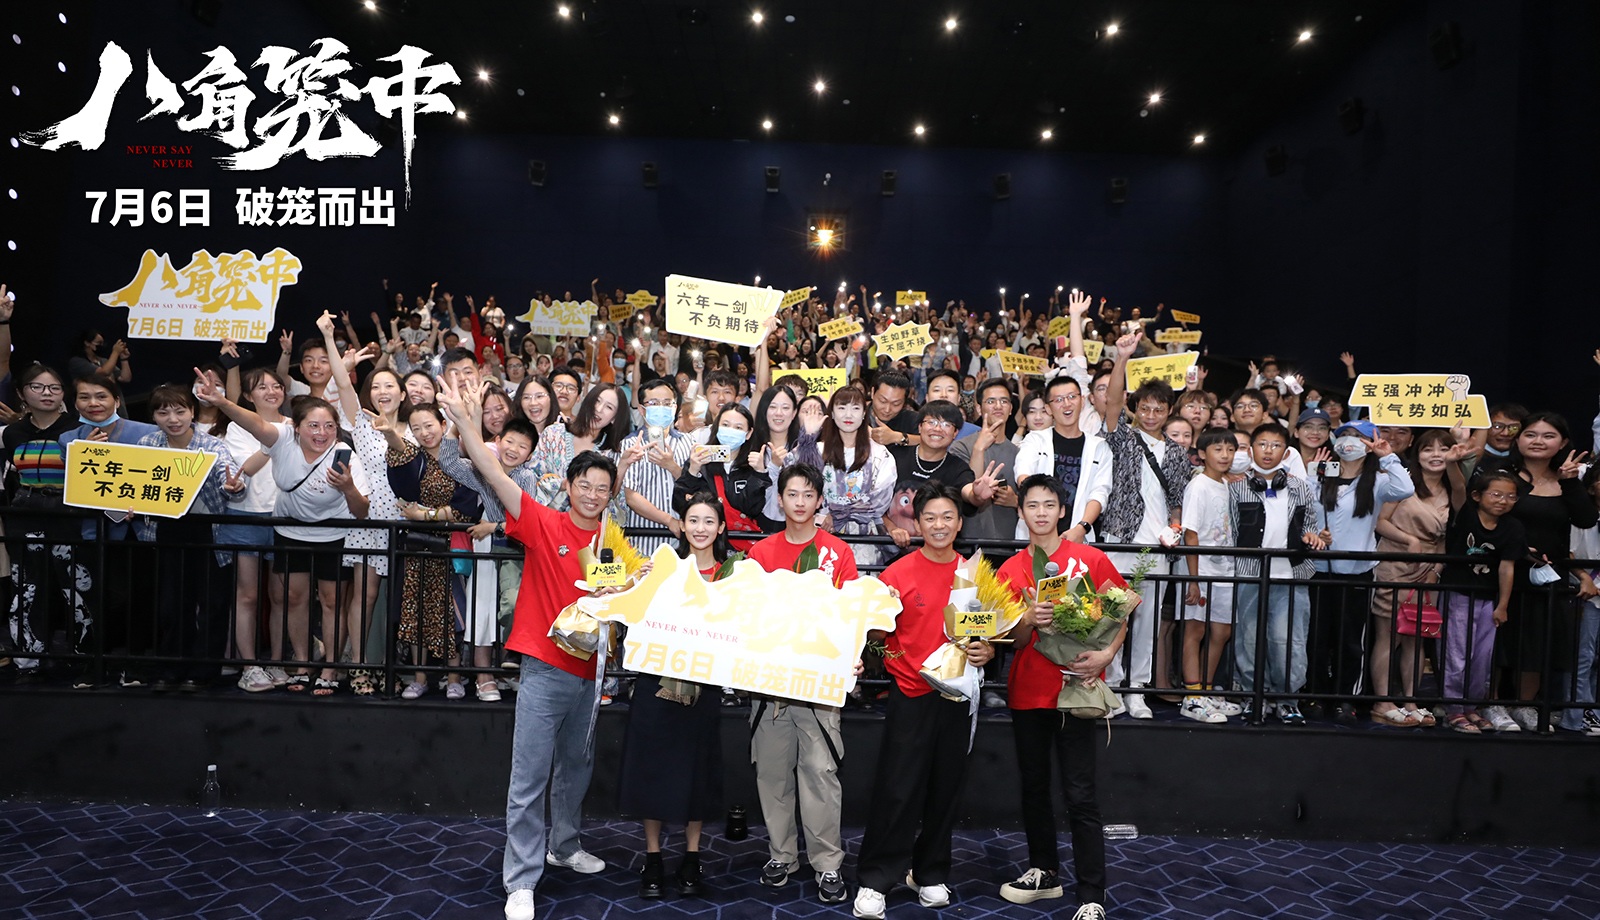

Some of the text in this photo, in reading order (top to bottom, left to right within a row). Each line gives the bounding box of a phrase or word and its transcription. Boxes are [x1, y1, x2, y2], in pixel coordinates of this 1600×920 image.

[677, 292, 747, 315] 六年一剑
[128, 317, 267, 341] 7月6日 破笼而出
[689, 311, 759, 334] 不负期待
[880, 327, 920, 344] 生如野草
[1132, 364, 1176, 376] 六年一剑
[1362, 383, 1445, 397] 宝强冲冲
[1387, 403, 1472, 418] 气势如弘
[79, 459, 171, 482] 六年一剑
[94, 481, 184, 503] 不负期待
[645, 620, 739, 644] NEVER SAY NEVER
[625, 640, 846, 706] 7月6日 破笼而出
